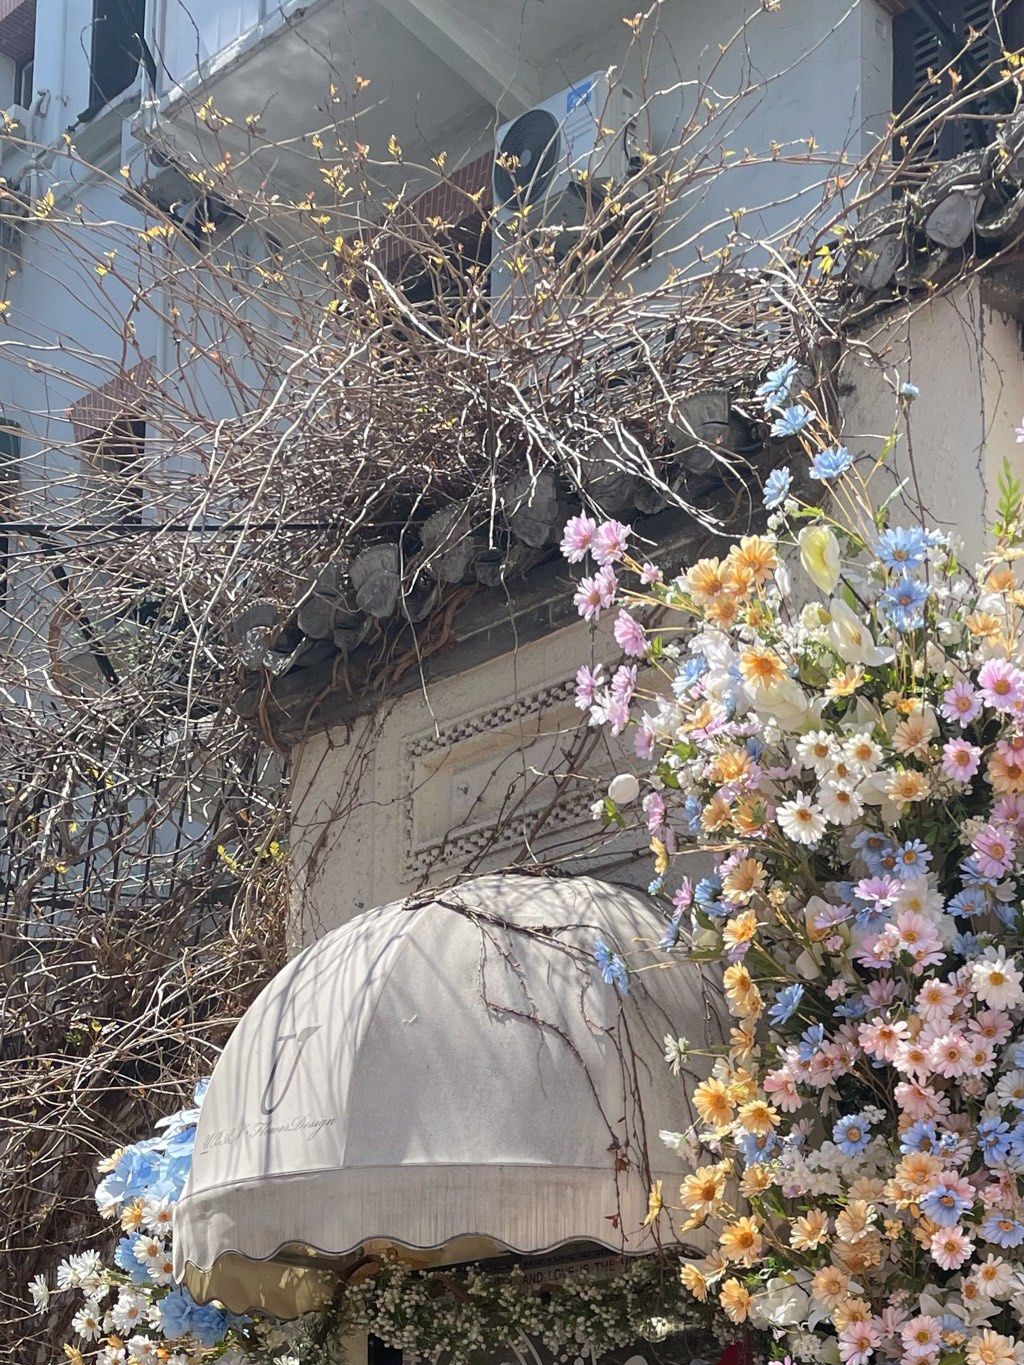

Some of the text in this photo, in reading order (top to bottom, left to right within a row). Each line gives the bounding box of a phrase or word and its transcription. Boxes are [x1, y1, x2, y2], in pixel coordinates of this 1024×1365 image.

[290, 1116, 336, 1141] Design
[522, 1271, 544, 1286] AND
[594, 1259, 616, 1273] THE
